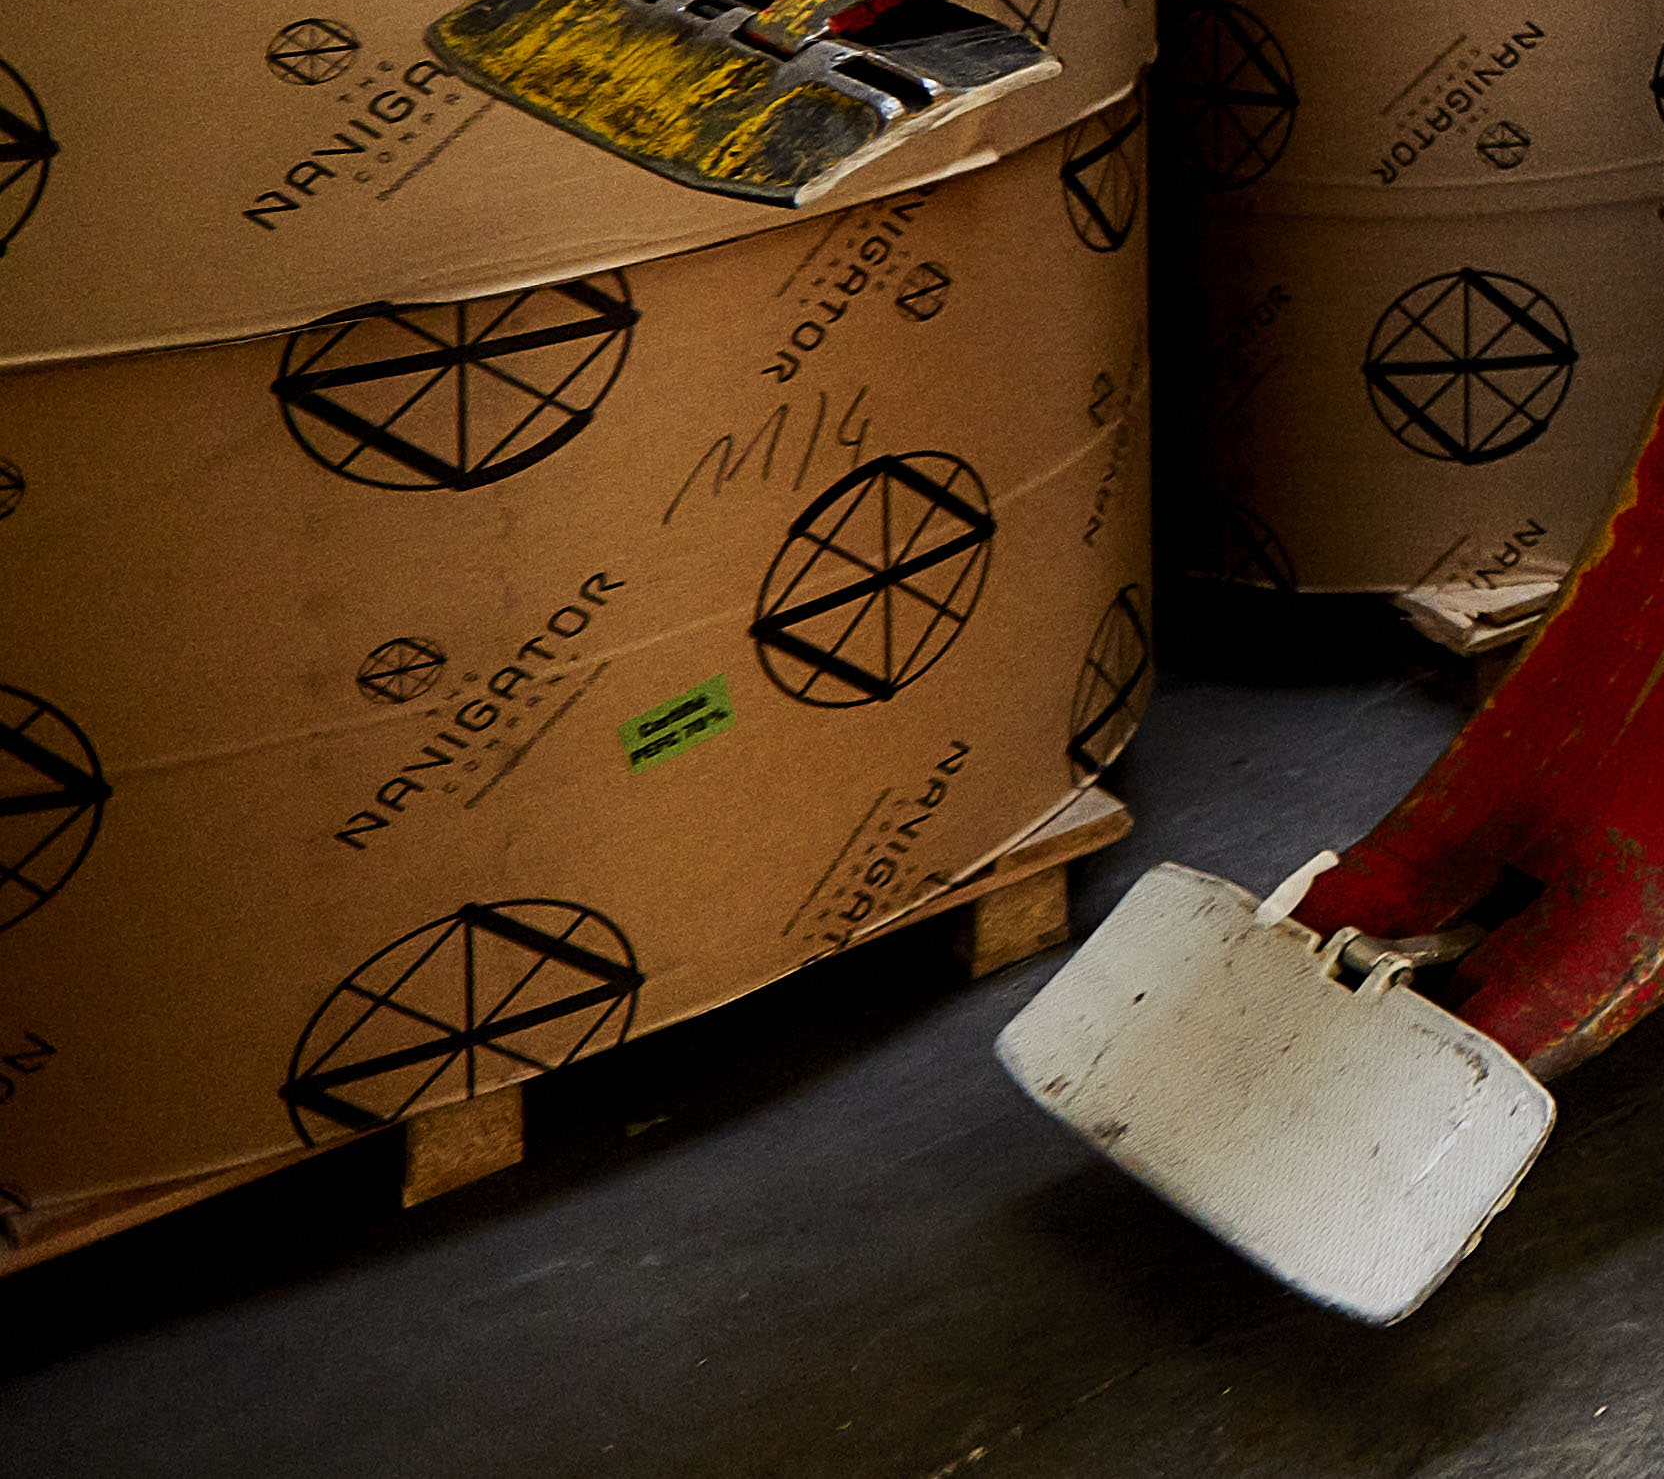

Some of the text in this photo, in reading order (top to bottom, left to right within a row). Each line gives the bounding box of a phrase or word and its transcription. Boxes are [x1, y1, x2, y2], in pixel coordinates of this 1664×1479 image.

[243, 59, 449, 232] NAVIGA
[1372, 20, 1545, 186] NAVIGATOR
[334, 569, 625, 850] NAVIGATOR
